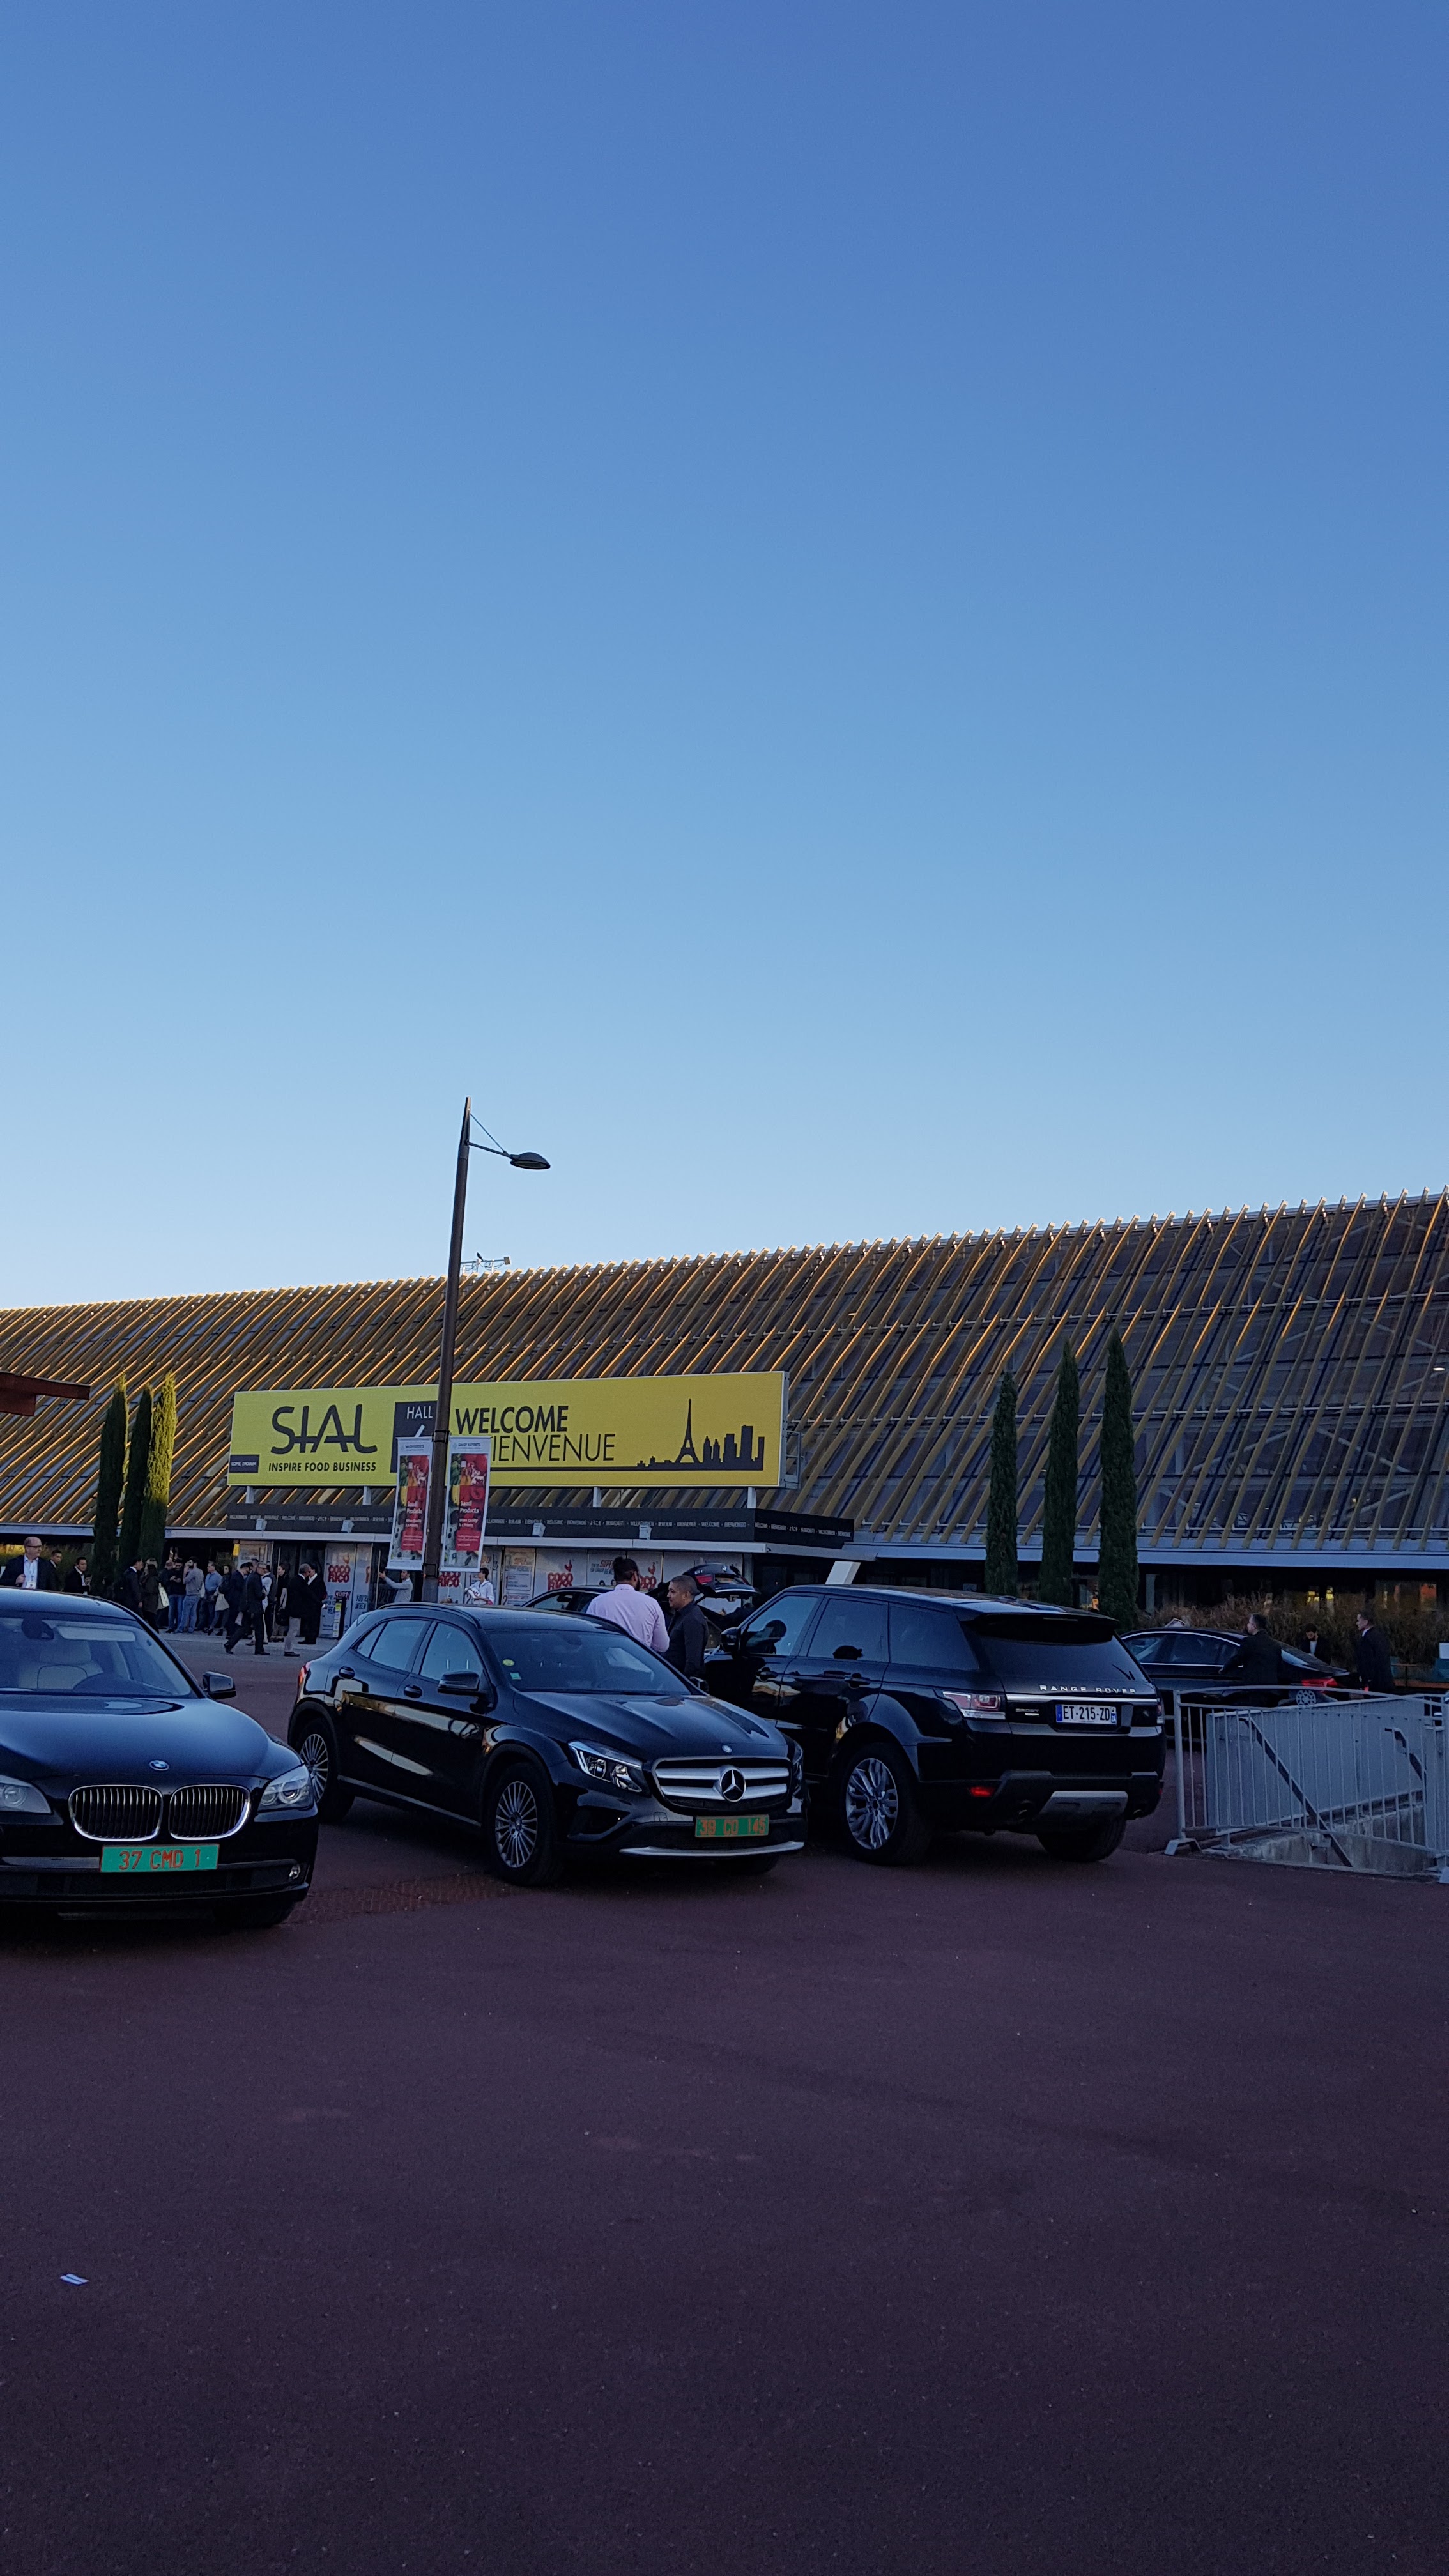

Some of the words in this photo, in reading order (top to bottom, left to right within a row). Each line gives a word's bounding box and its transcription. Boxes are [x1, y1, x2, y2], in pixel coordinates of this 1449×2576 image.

[406, 1405, 433, 1420] HALL
[455, 1405, 569, 1435] WELCOME
[270, 1404, 378, 1455] SIAL
[491, 1434, 616, 1462] IENVENUE
[268, 1462, 302, 1472] INSPIRE
[305, 1462, 330, 1471] FOOD
[333, 1462, 376, 1471] BUSINESS
[328, 1572, 350, 1583] RICO
[1063, 1706, 1110, 1721] ET-215-ZD
[700, 1819, 716, 1835] 39
[724, 1819, 739, 1835] CD
[747, 1818, 766, 1835] 145
[119, 1851, 142, 1870] 37
[150, 1850, 184, 1869] CMD
[195, 1848, 201, 1867] 1
